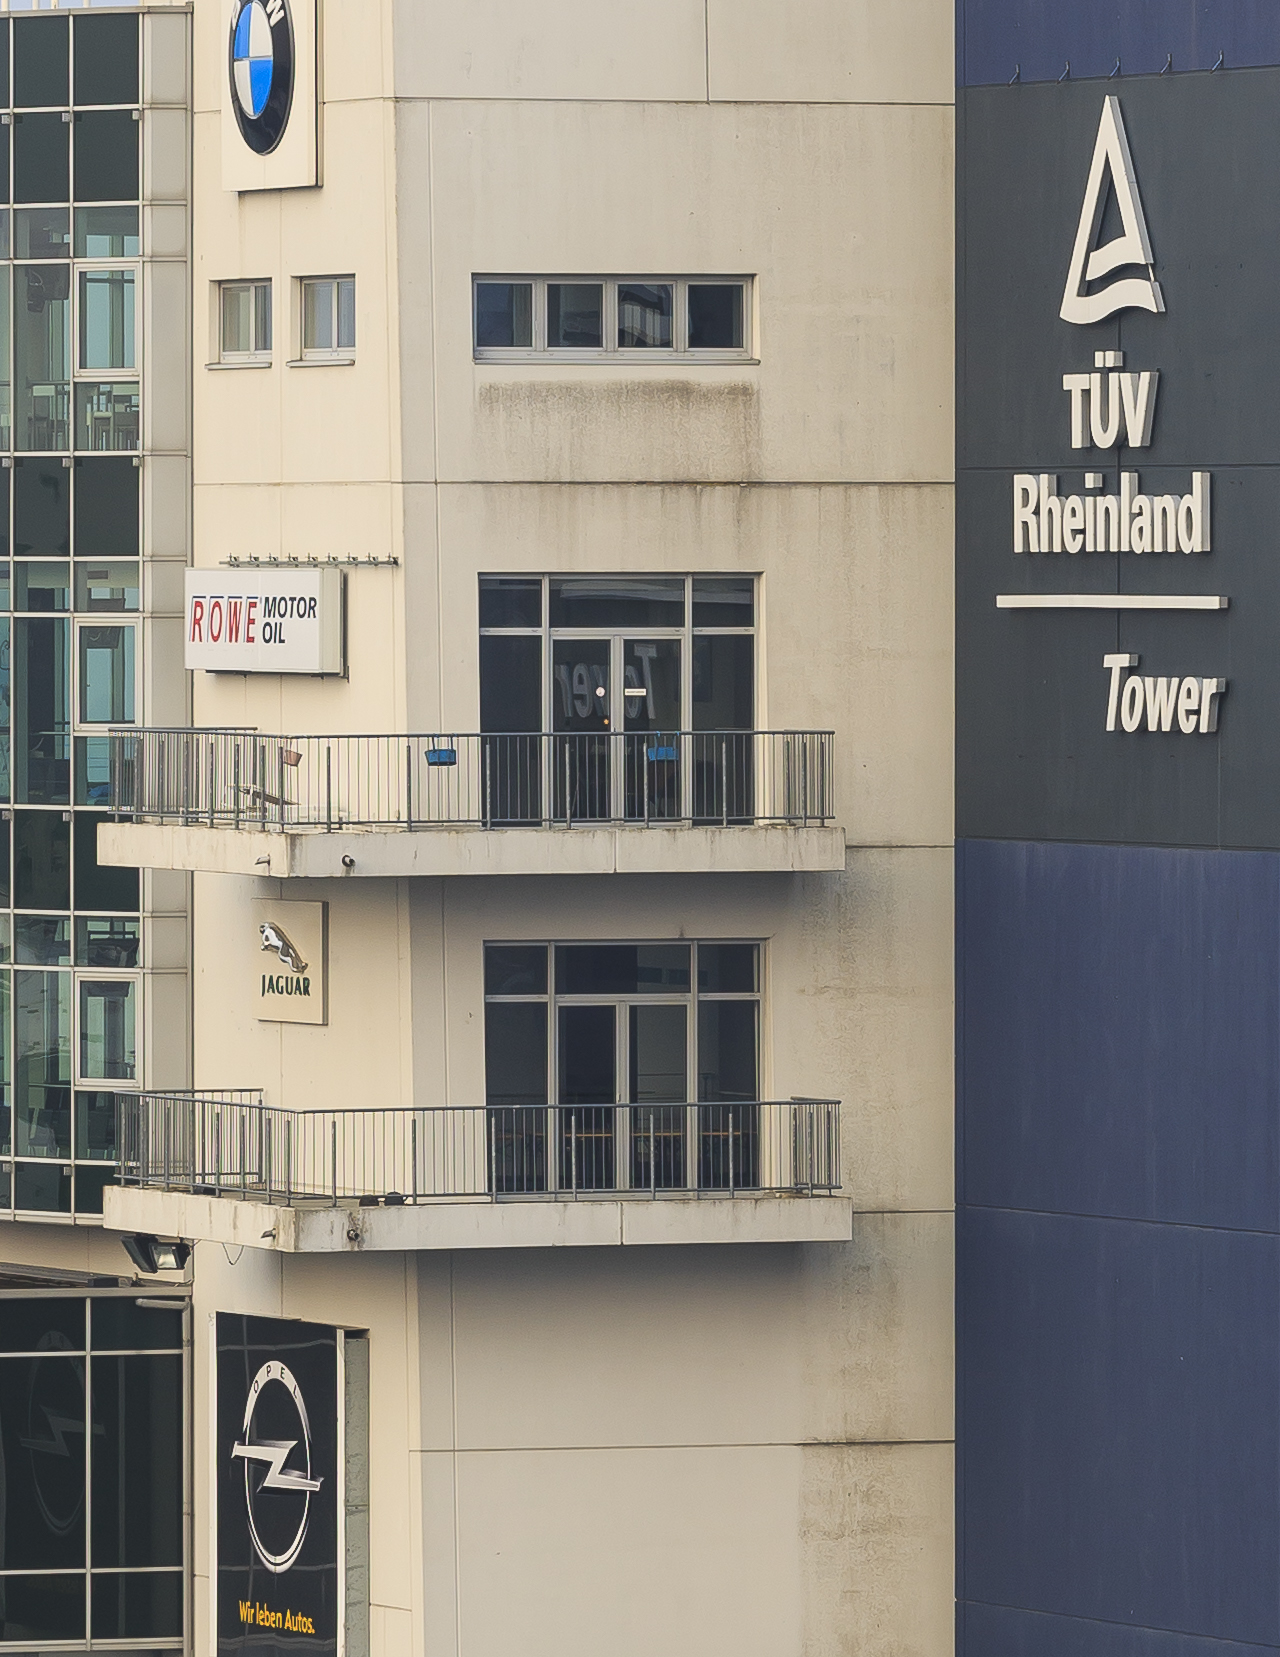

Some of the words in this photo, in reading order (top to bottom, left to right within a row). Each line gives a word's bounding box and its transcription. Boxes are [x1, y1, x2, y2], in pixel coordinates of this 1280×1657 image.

[1062, 350, 1159, 449] TÜV
[1013, 471, 1211, 555] Rheinland
[190, 595, 258, 644] ROWE
[263, 595, 317, 619] MOTOR
[261, 621, 286, 645] OIL
[1103, 654, 1226, 734] Tower
[260, 974, 311, 998] JAGUAR
[252, 1364, 299, 1400] OPEL
[238, 1600, 254, 1624] Wir
[255, 1601, 283, 1628] leben
[284, 1608, 316, 1634] Autos.
